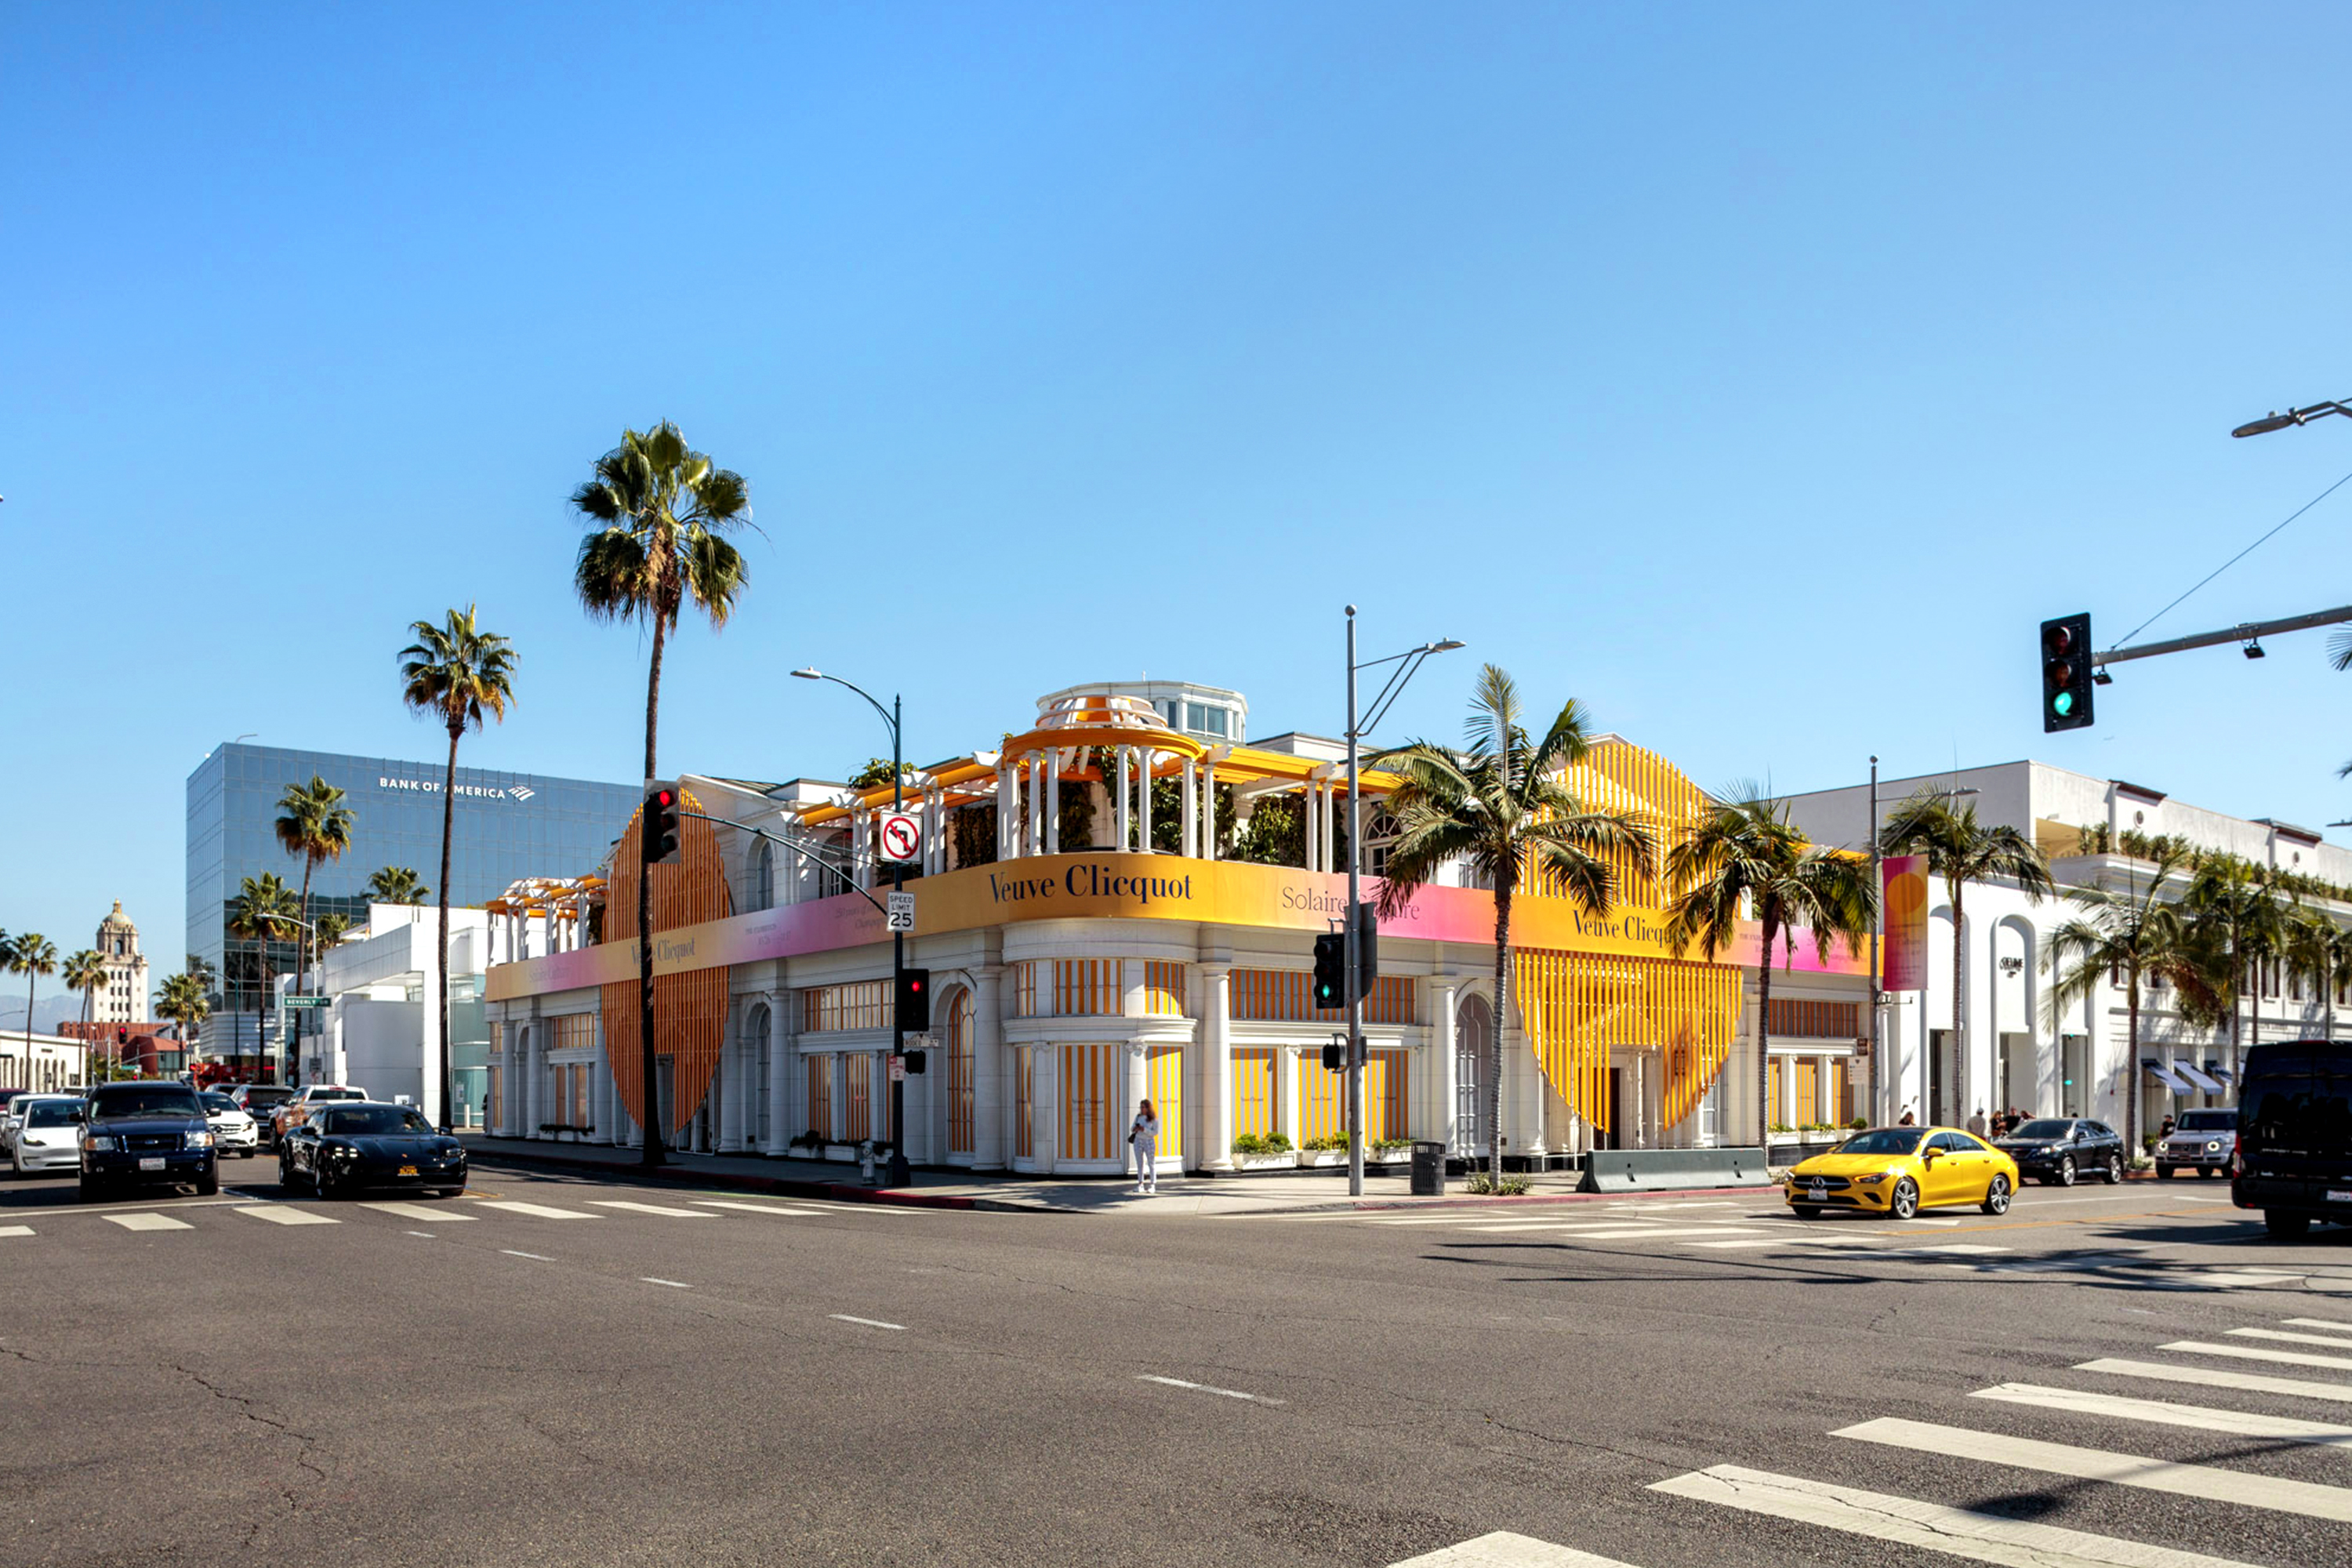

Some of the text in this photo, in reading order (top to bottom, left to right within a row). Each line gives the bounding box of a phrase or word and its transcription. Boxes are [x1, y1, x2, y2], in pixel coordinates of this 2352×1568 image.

[379, 777, 419, 790] BANK
[422, 782, 440, 793] OF
[989, 864, 1194, 905] Veuve Clicquot
[889, 895, 913, 904] SPEED
[1282, 886, 1348, 913] Solaire
[890, 912, 913, 927] 25
[1572, 909, 1620, 938] Veuve
[658, 936, 695, 964] Clicquot
